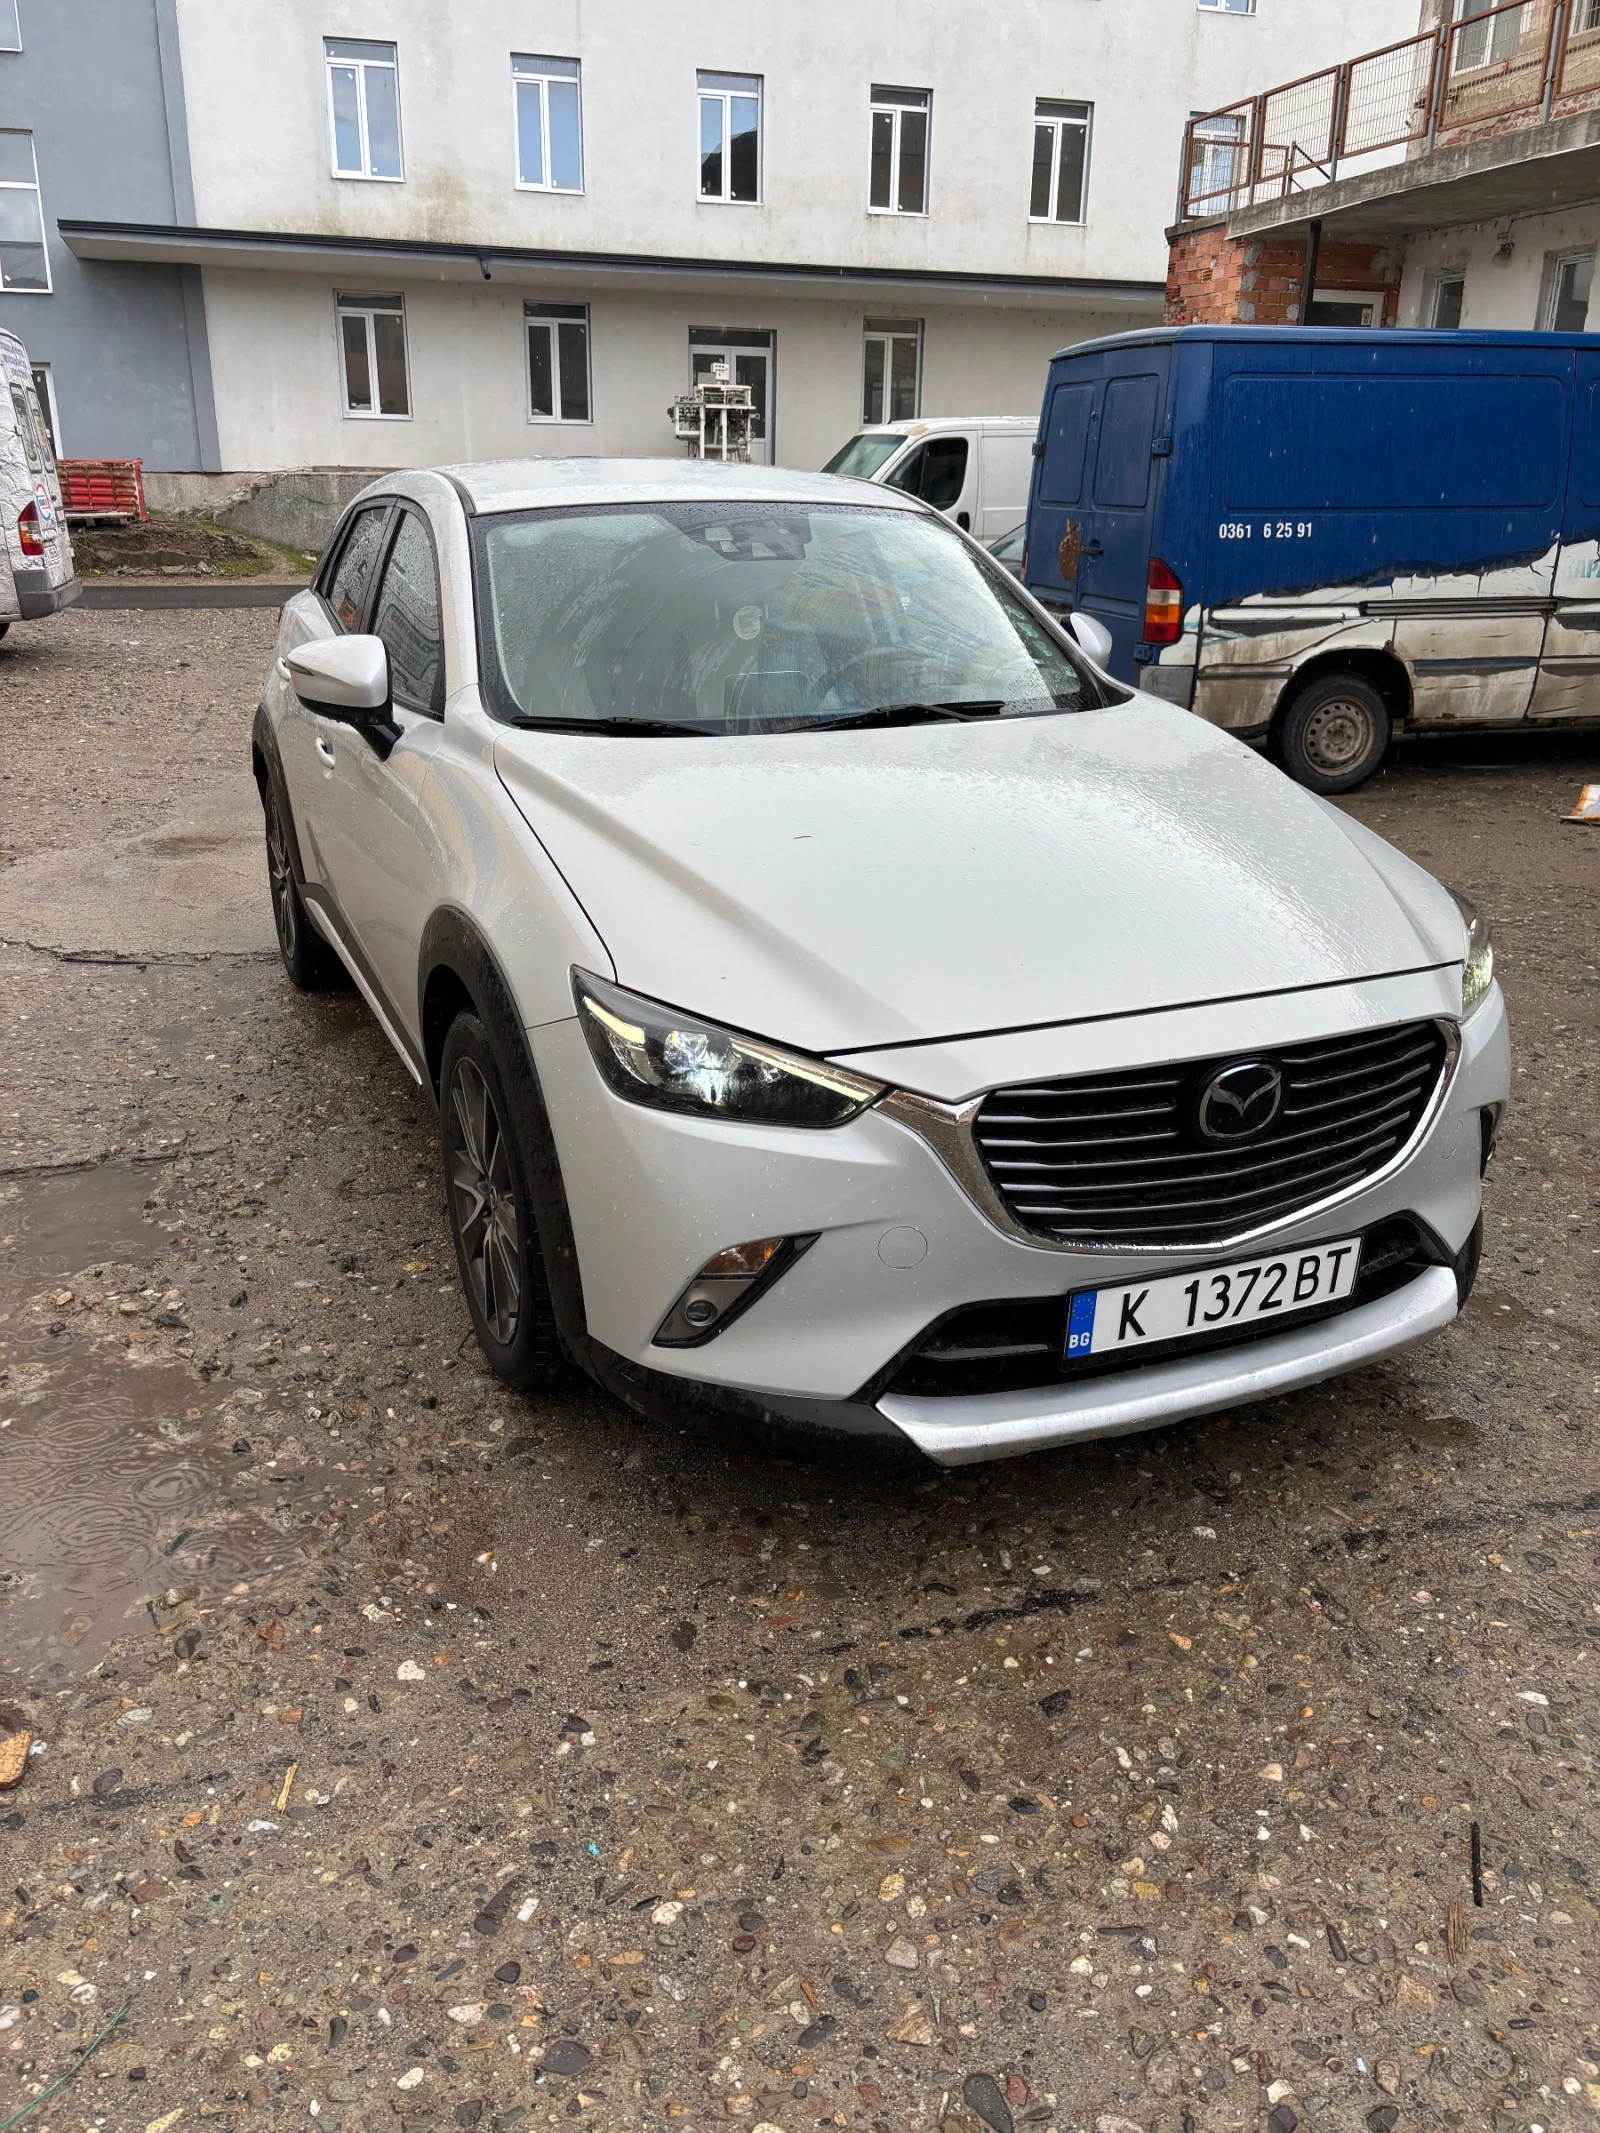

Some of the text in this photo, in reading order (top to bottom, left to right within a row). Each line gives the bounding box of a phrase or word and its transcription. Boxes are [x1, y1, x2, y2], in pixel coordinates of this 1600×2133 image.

[1218, 522, 1313, 539] 0361 6 25 91
[1117, 1288, 1150, 1341] K
[1068, 1332, 1090, 1349] BG
